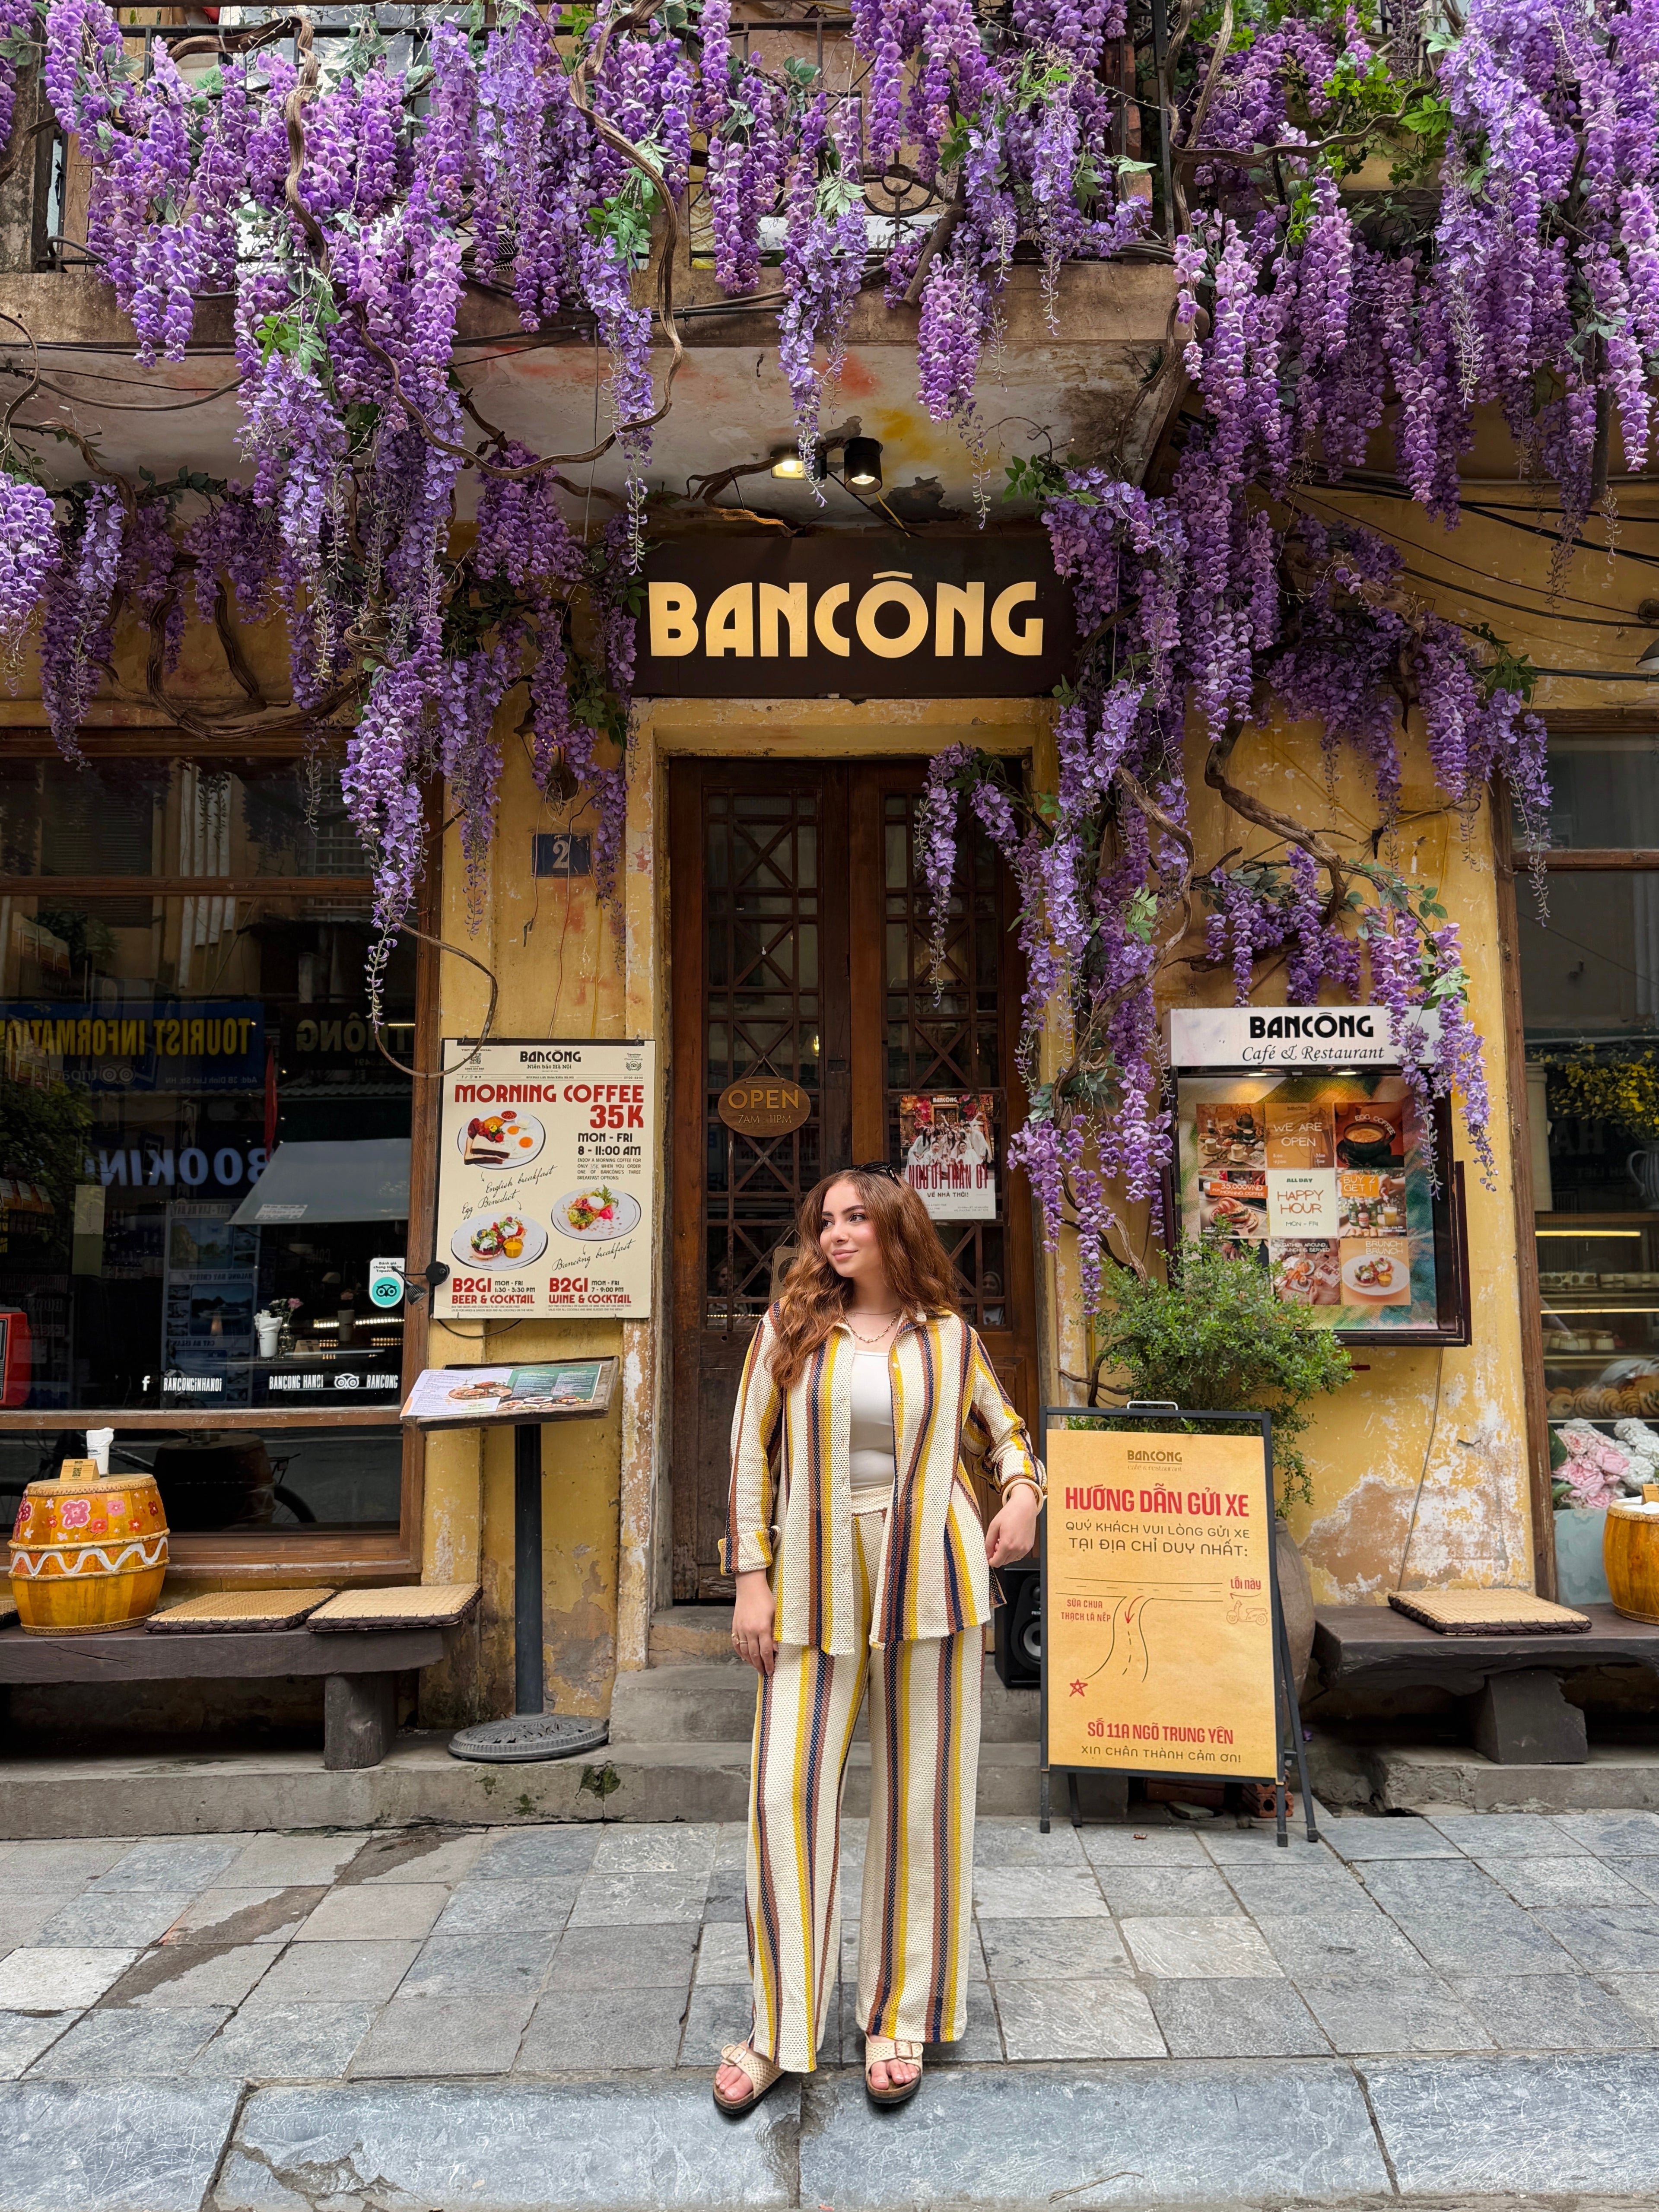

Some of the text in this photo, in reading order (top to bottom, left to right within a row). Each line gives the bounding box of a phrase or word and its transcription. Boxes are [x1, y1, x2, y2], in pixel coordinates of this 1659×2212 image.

[552, 840, 569, 868] 2
[1242, 1044, 1385, 1064] Café & Restaurant
[455, 1084, 644, 1103] MORNING COFFEE
[728, 1089, 798, 1109] OPEN
[590, 1104, 644, 1129] 35K
[738, 1114, 791, 1123] 7AM 11PM
[1273, 1122, 1322, 1131] WE ARE
[1373, 1116, 1396, 1135] COFFEE
[578, 1132, 606, 1142] MON
[617, 1133, 632, 1142] FRI
[1281, 1137, 1316, 1146] OPEN
[578, 1146, 585, 1155] 8
[623, 1146, 641, 1155] AM
[486, 1165, 558, 1198] English breakfast
[1343, 1176, 1363, 1184] BUY
[1344, 1184, 1365, 1192] GET
[1277, 1190, 1324, 1201] HAPPY
[462, 1189, 521, 1220] Egg Benedict
[1281, 1203, 1322, 1214] HOUR
[595, 1239, 636, 1259] breakfast
[452, 1294, 535, 1304] BEER & COCKTAIL
[549, 1294, 632, 1303] WINE & COCKTAIL
[269, 1375, 301, 1389] BANCONG
[366, 1375, 398, 1389] BANCONG
[1065, 1483, 1249, 1517] HƯỚNG DẪN GỬI XE
[1066, 1519, 1250, 1538] QUÝ KHÁCH VUI LÒNG GỬI XE
[1068, 1537, 1248, 1557] TẠI ĐỊA CHỈ DUY NHẤT:
[1084, 1600, 1103, 1608] CHUA
[1087, 1718, 1233, 1744] SỐ 11A NGÕ TRUNG YÊN
[1081, 1746, 1101, 1754] XIN
[1105, 1745, 1138, 1757] CHÂN
[1143, 1747, 1183, 1759] THÀNH
[1188, 1750, 1215, 1761] CẢM
